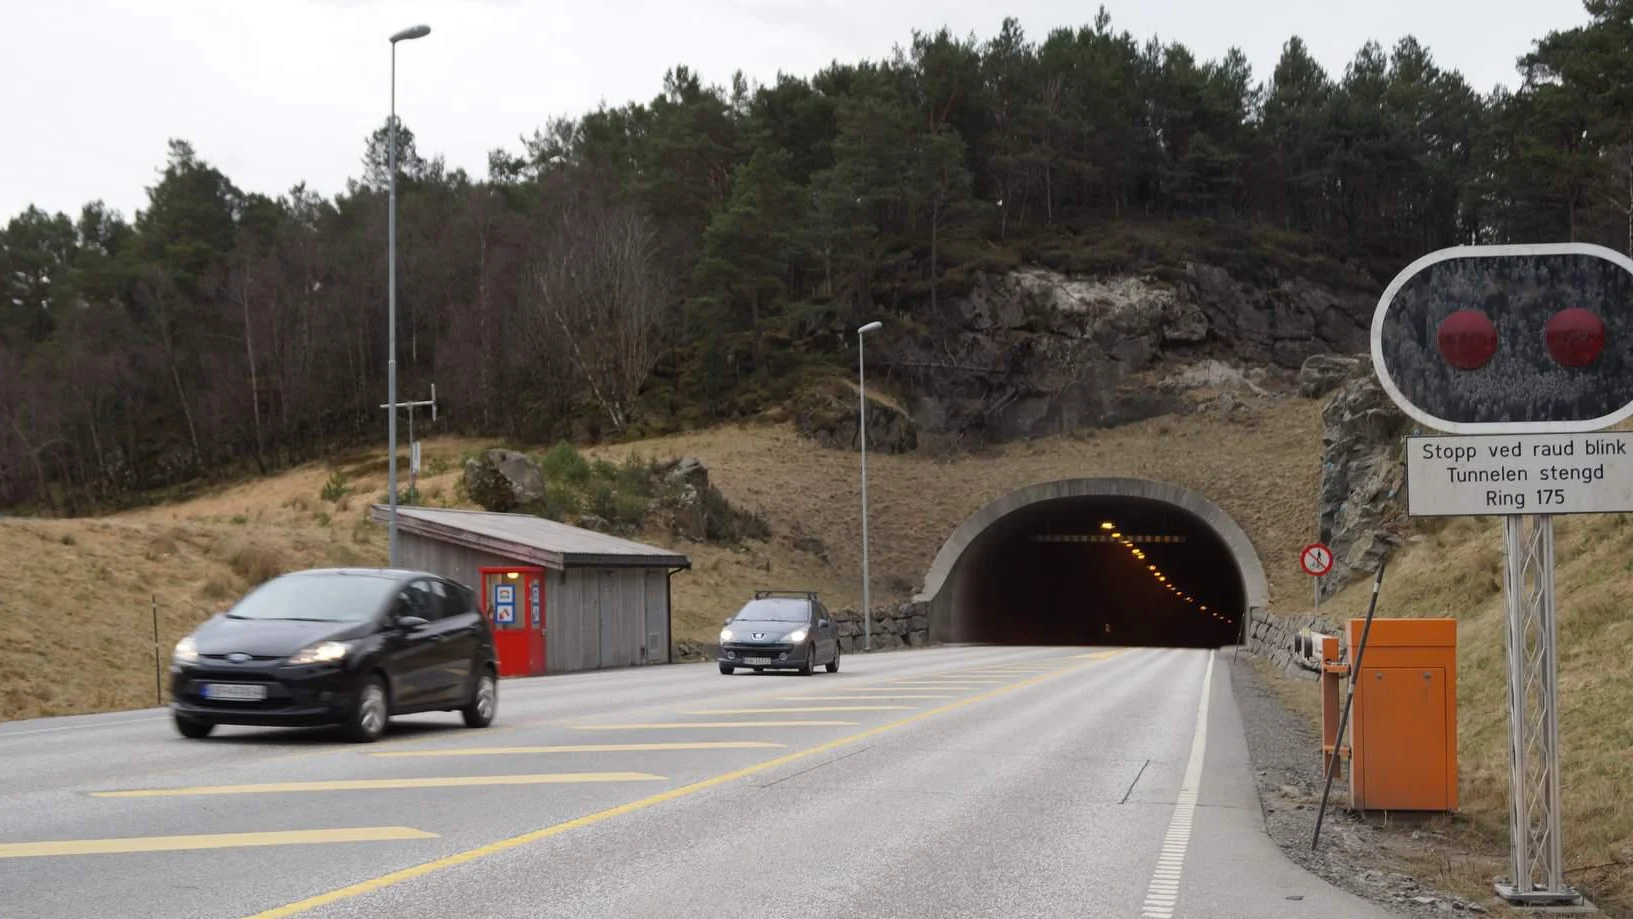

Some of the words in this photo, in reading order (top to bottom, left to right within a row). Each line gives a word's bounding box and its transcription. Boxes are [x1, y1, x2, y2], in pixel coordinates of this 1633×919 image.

[1423, 444, 1477, 462] Stopp
[1489, 442, 1522, 457] ved
[1533, 440, 1574, 456] raud
[1585, 439, 1627, 456] blink
[1447, 466, 1527, 482] Tunnelen
[1540, 464, 1604, 483] stengd
[1486, 490, 1525, 509] Ring
[1537, 489, 1565, 504] 175
